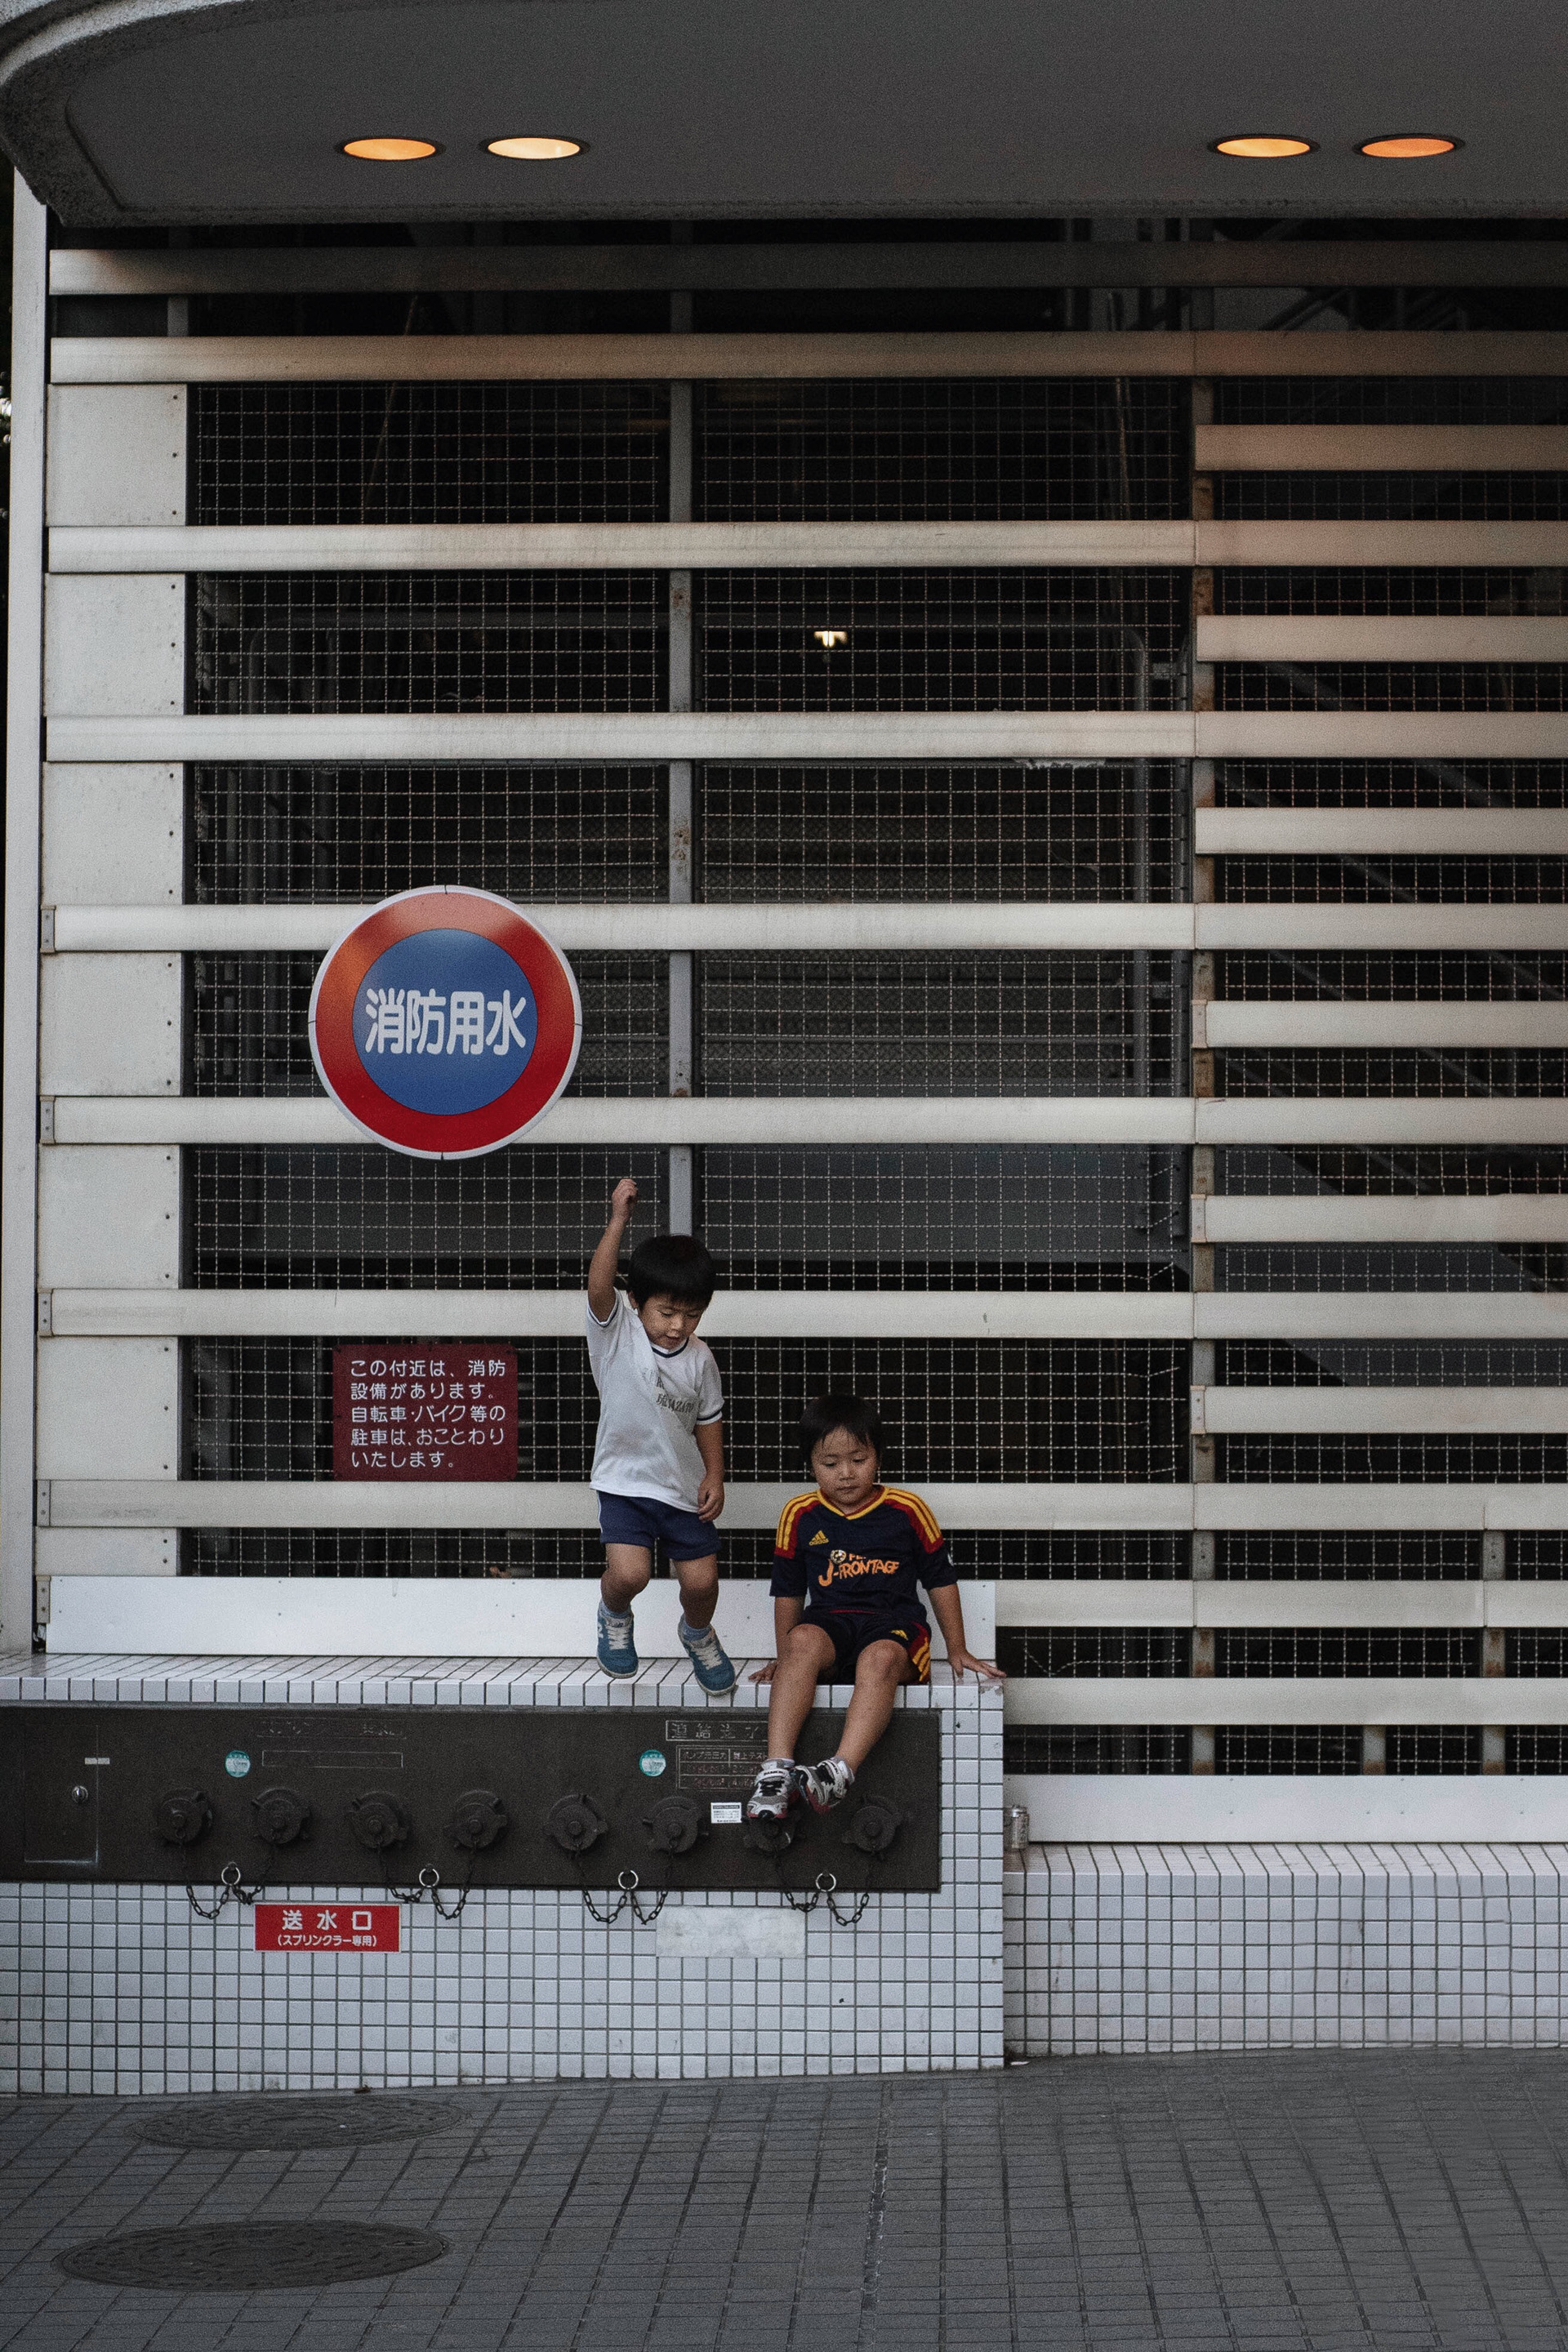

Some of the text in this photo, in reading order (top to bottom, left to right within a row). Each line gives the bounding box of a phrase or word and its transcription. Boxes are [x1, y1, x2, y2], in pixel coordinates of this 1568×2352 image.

[365, 987, 527, 1055] 消防用水
[350, 1382, 493, 1401] 設備があります。
[351, 1428, 505, 1446] 駐車は、おことわり
[351, 1451, 454, 1468] いたします。
[808, 1538, 830, 1547] adidas
[282, 1909, 372, 1931] 送水口
